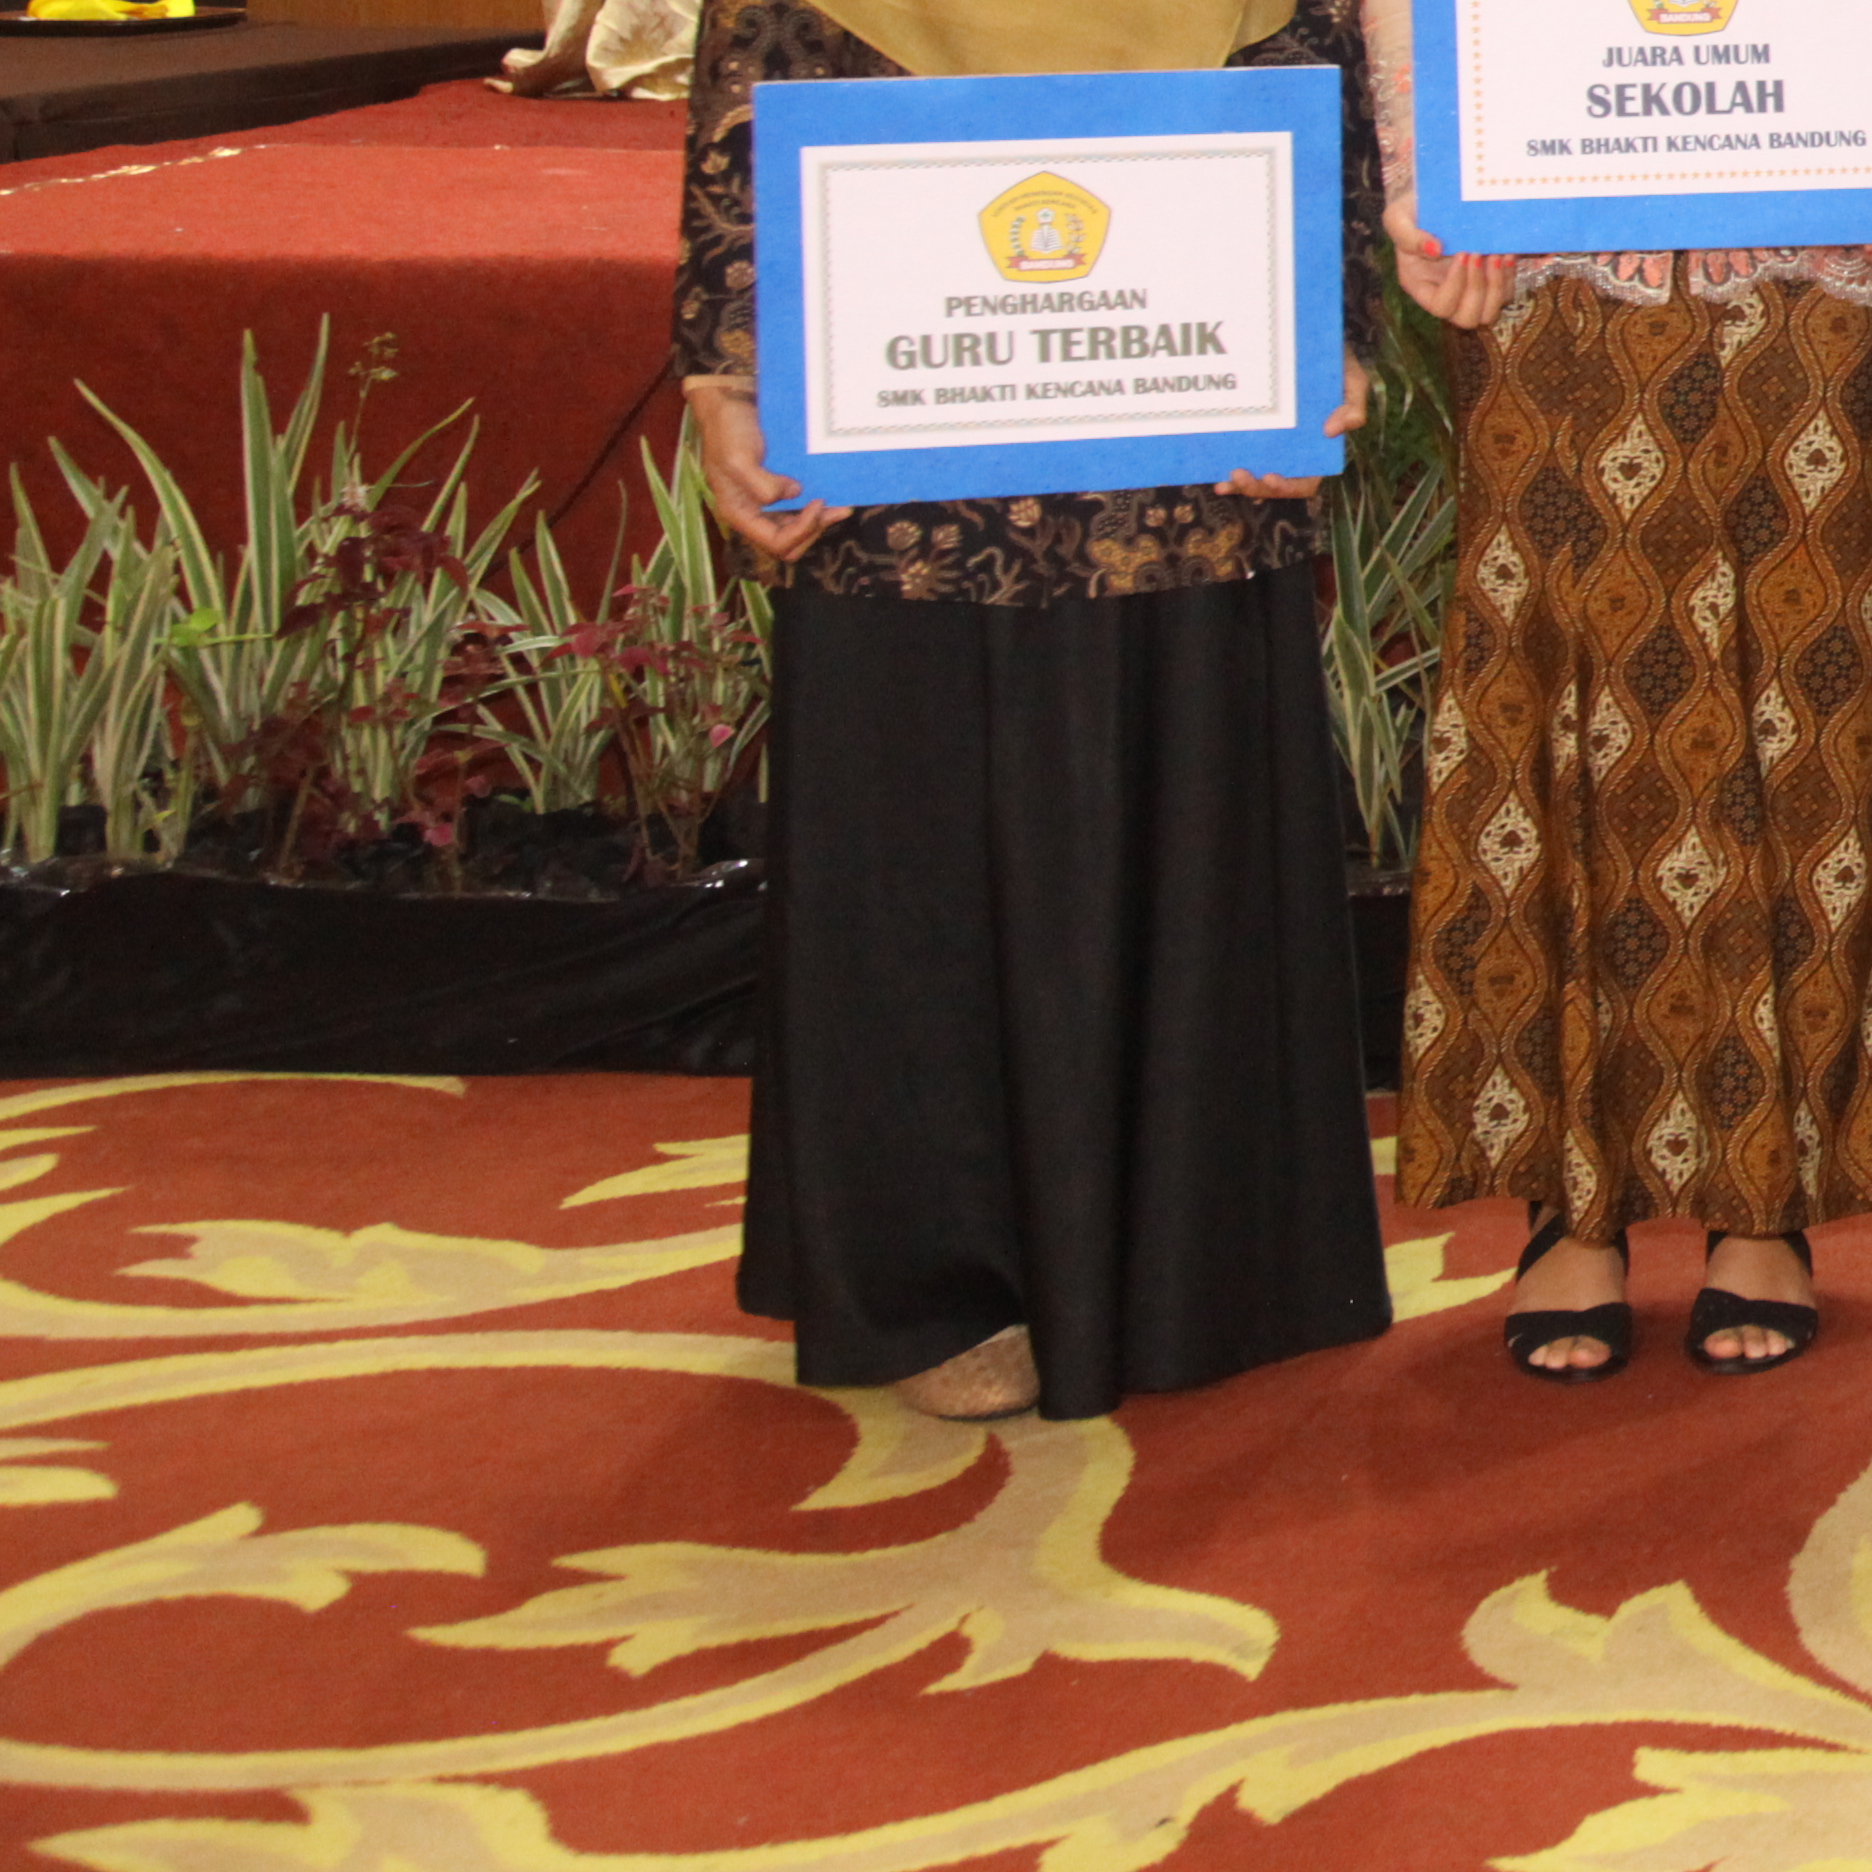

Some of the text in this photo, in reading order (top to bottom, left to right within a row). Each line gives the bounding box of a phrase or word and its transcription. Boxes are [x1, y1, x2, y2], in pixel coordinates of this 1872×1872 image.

[1601, 43, 1771, 68] JUARA UMUM
[1586, 79, 1786, 119] SEKOLAH
[1526, 129, 1867, 157] SMK BHAKTI KENCANA BANDUNG
[945, 288, 1149, 318] PENGHARGAAN
[884, 321, 1228, 371] GURU TERBAIK
[876, 372, 1238, 408] SMK BHAKTI KENCANA BANDUNG
